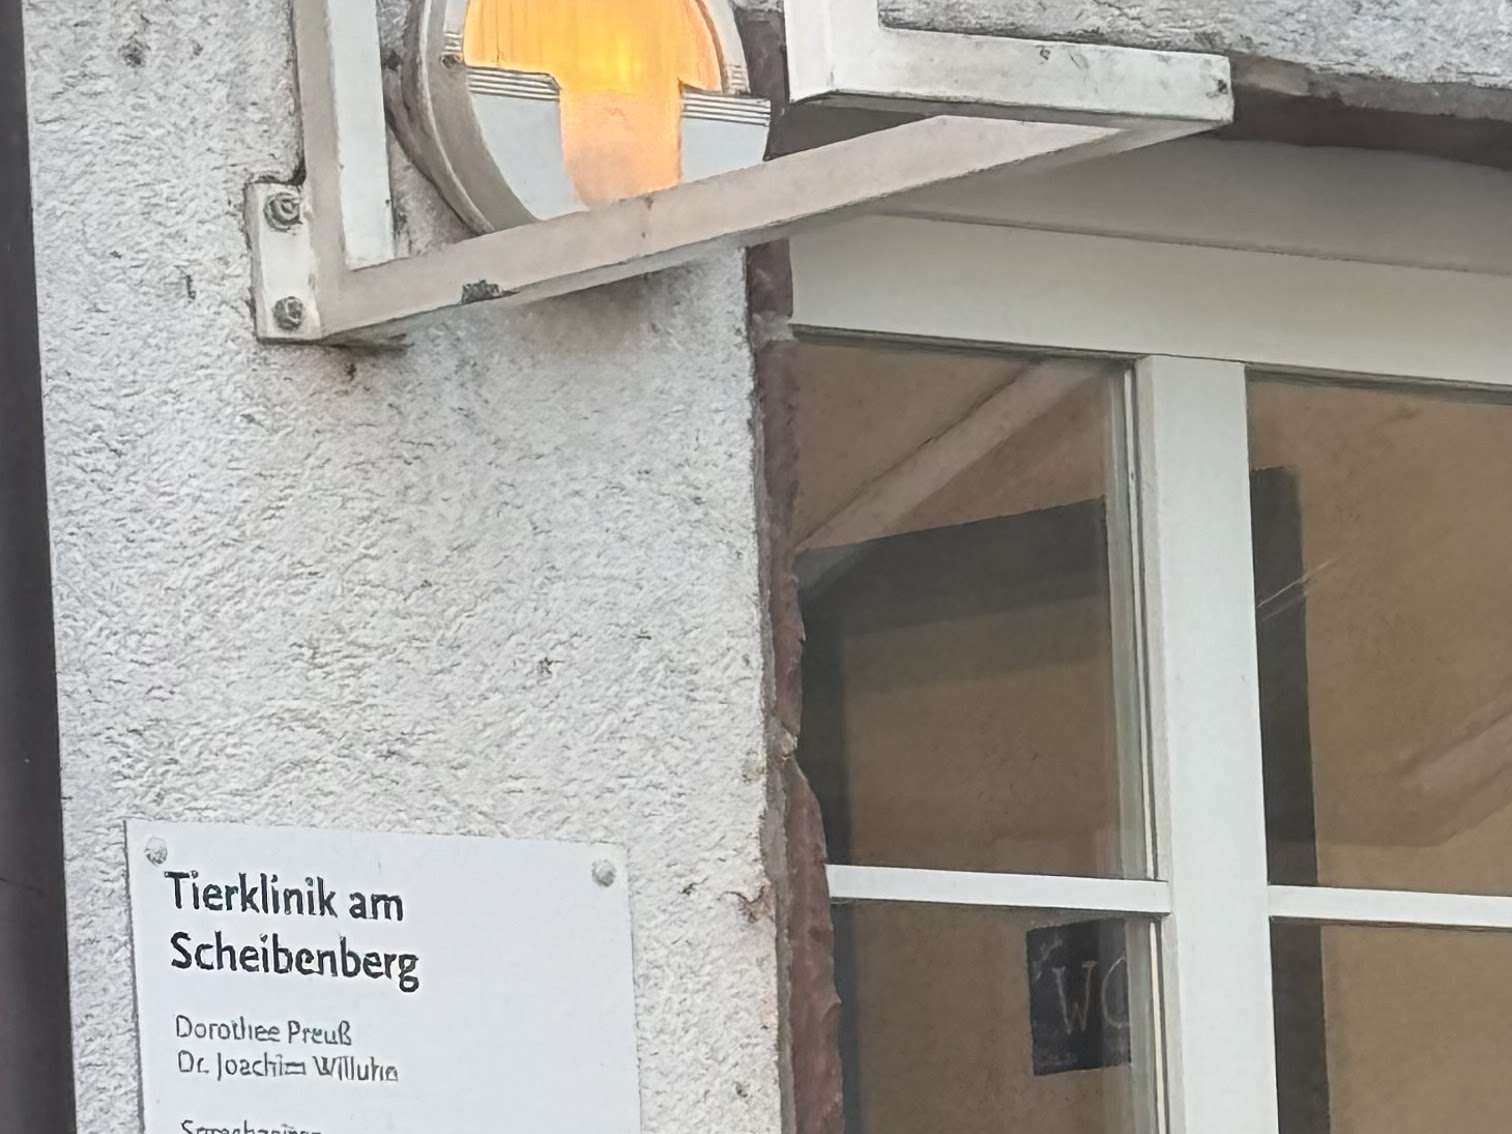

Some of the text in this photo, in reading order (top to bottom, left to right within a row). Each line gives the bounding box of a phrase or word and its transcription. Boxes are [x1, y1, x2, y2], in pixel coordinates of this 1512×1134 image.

[164, 870, 403, 922] Tierklinik am
[170, 930, 419, 993] Scheibenberg
[175, 1014, 352, 1046] Dorothee Preuß
[216, 1051, 307, 1081] Joachim
